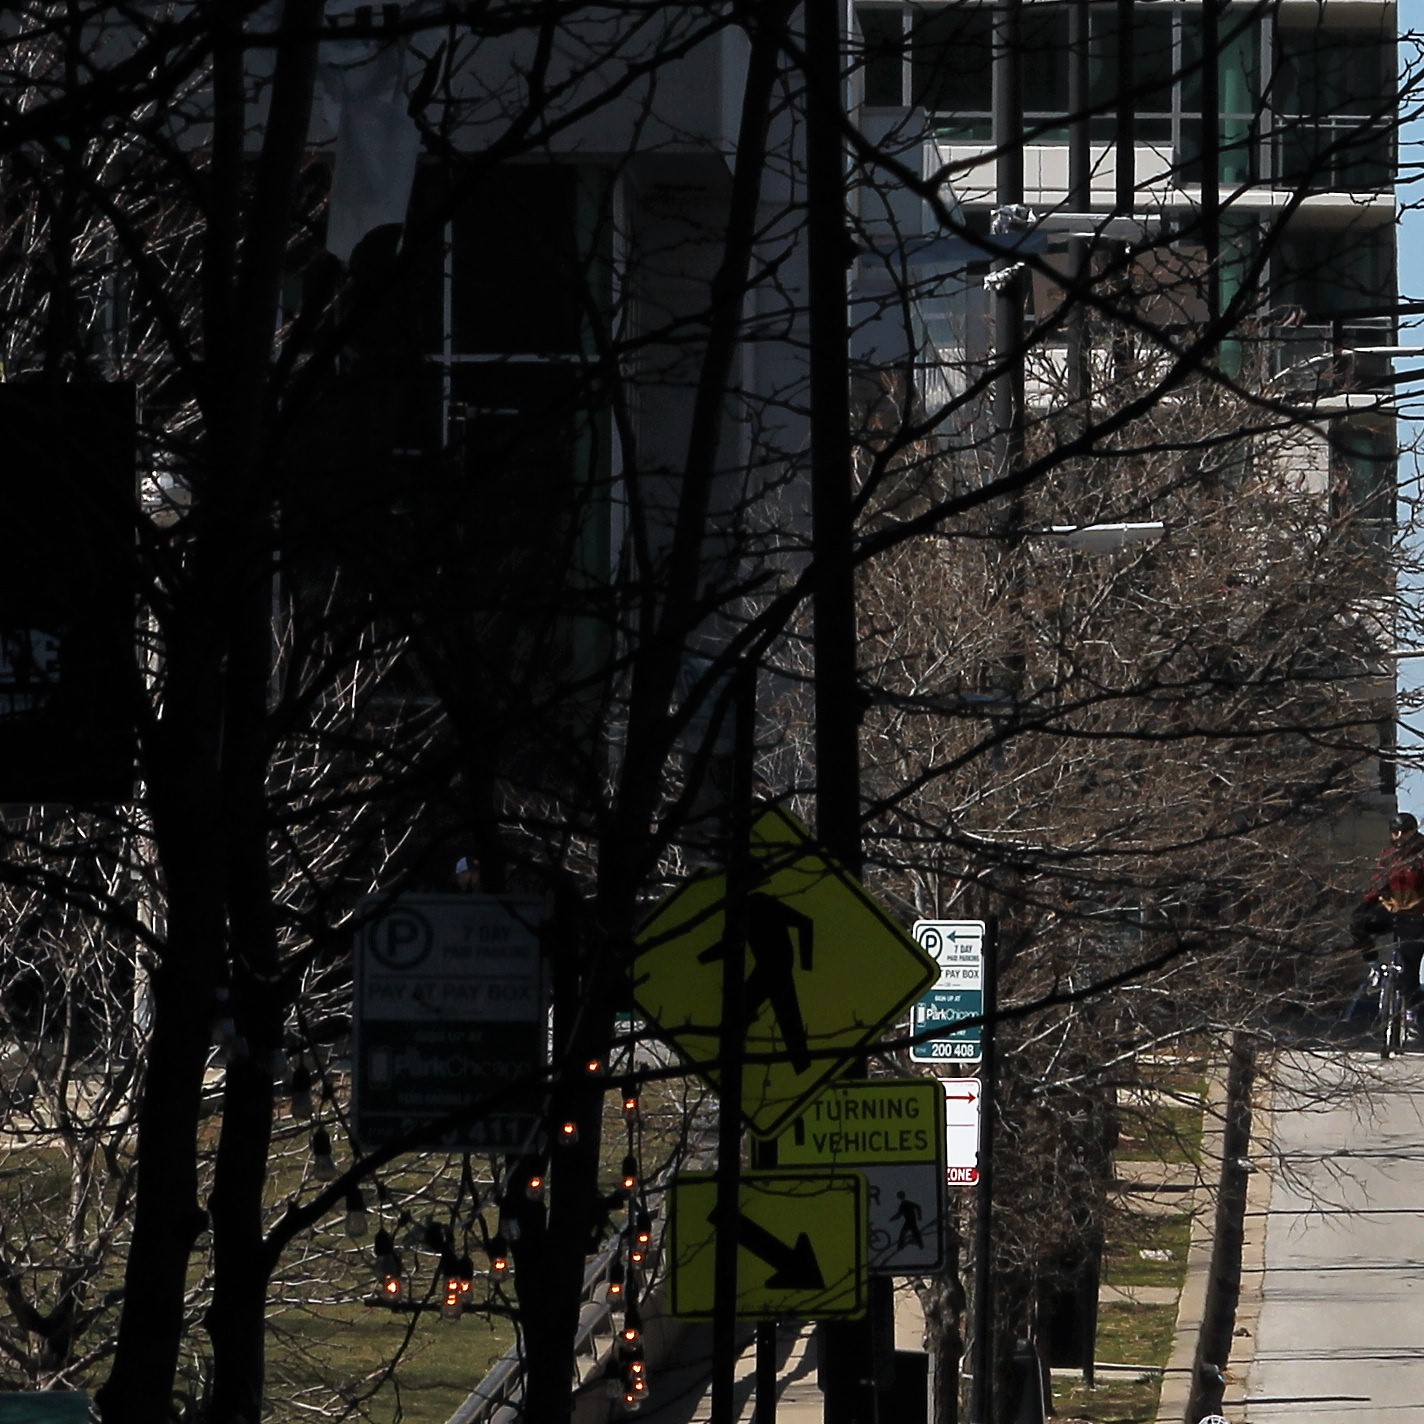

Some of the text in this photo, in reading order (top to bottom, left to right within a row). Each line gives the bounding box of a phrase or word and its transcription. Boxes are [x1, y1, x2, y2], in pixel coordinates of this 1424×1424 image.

[945, 969, 960, 978] PAY
[962, 969, 980, 978] BOX
[368, 982, 532, 1000] PAY AT PAY BOX
[931, 1043, 952, 1057] 200
[954, 1043, 974, 1057] 408
[813, 1097, 920, 1122] TURNING
[812, 1129, 929, 1153] VEHICLES
